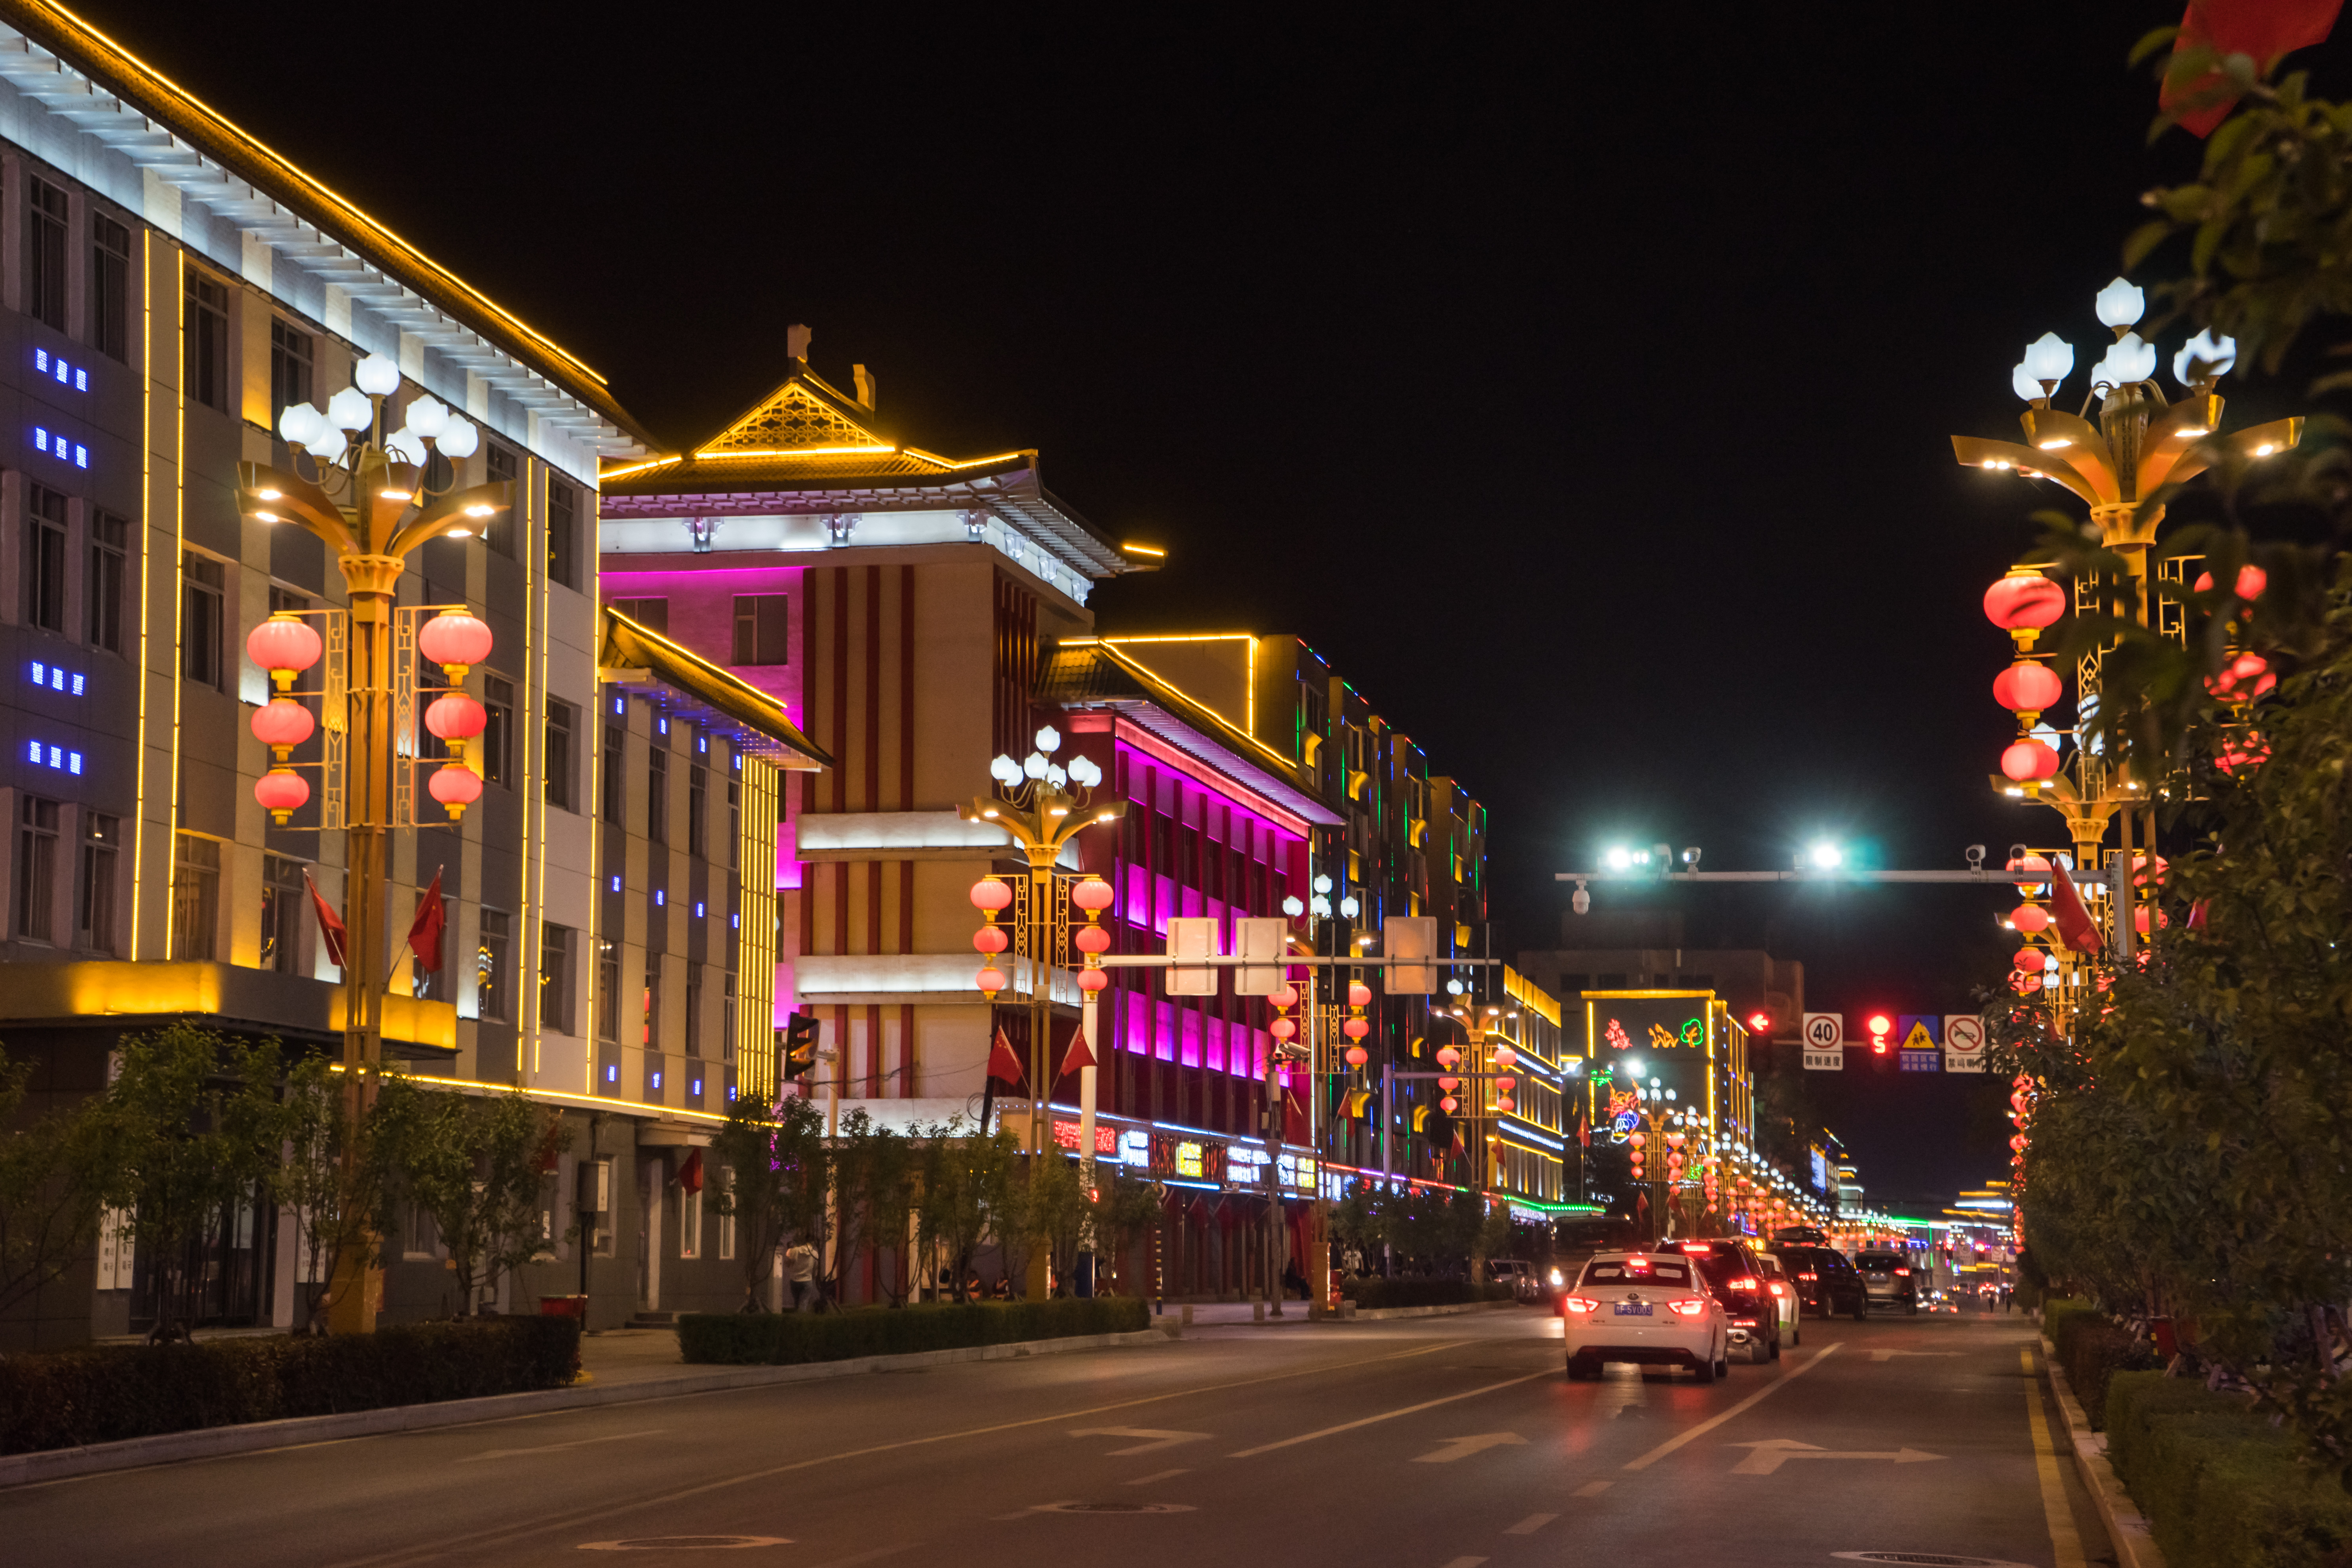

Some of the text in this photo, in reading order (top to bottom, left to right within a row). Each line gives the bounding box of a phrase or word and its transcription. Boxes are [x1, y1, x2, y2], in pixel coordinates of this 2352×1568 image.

[1813, 1023, 1833, 1041] 40
[1806, 1055, 1840, 1066] 限制速度
